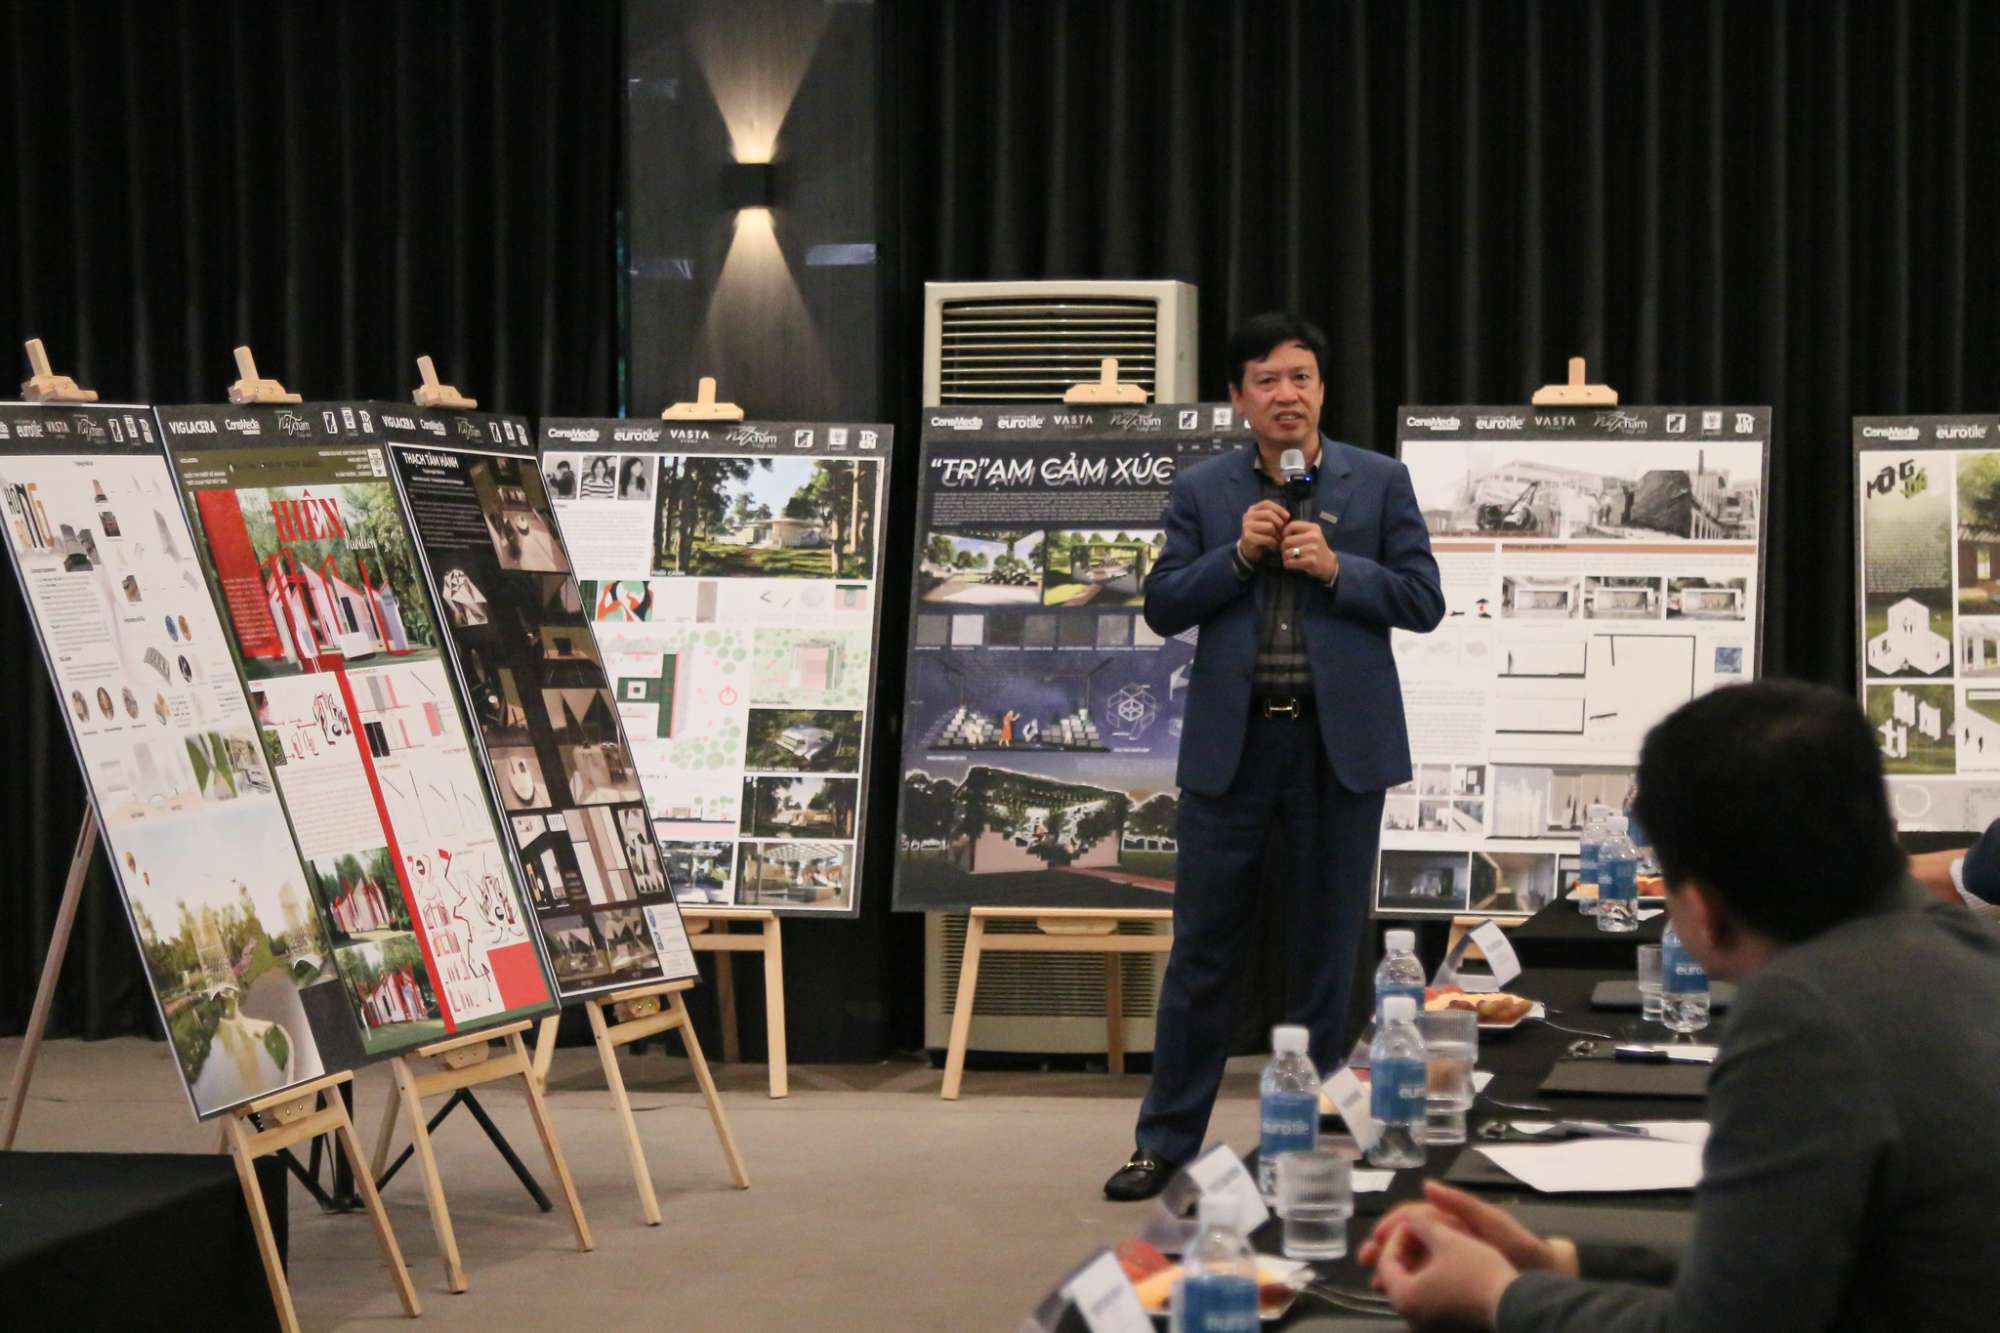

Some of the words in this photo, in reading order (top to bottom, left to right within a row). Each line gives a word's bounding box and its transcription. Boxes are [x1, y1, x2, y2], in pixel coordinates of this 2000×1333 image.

[169, 420, 217, 434] VIGLACERA
[997, 416, 1045, 429] eurotile
[1053, 415, 1094, 425] VASTA
[1476, 416, 1525, 430] eurotile
[1535, 416, 1576, 426] VASTA
[670, 429, 710, 440] VASTA
[1936, 424, 1987, 439] eurotile
[1040, 451, 1106, 480] CẢM
[1111, 452, 1174, 479] XÚC
